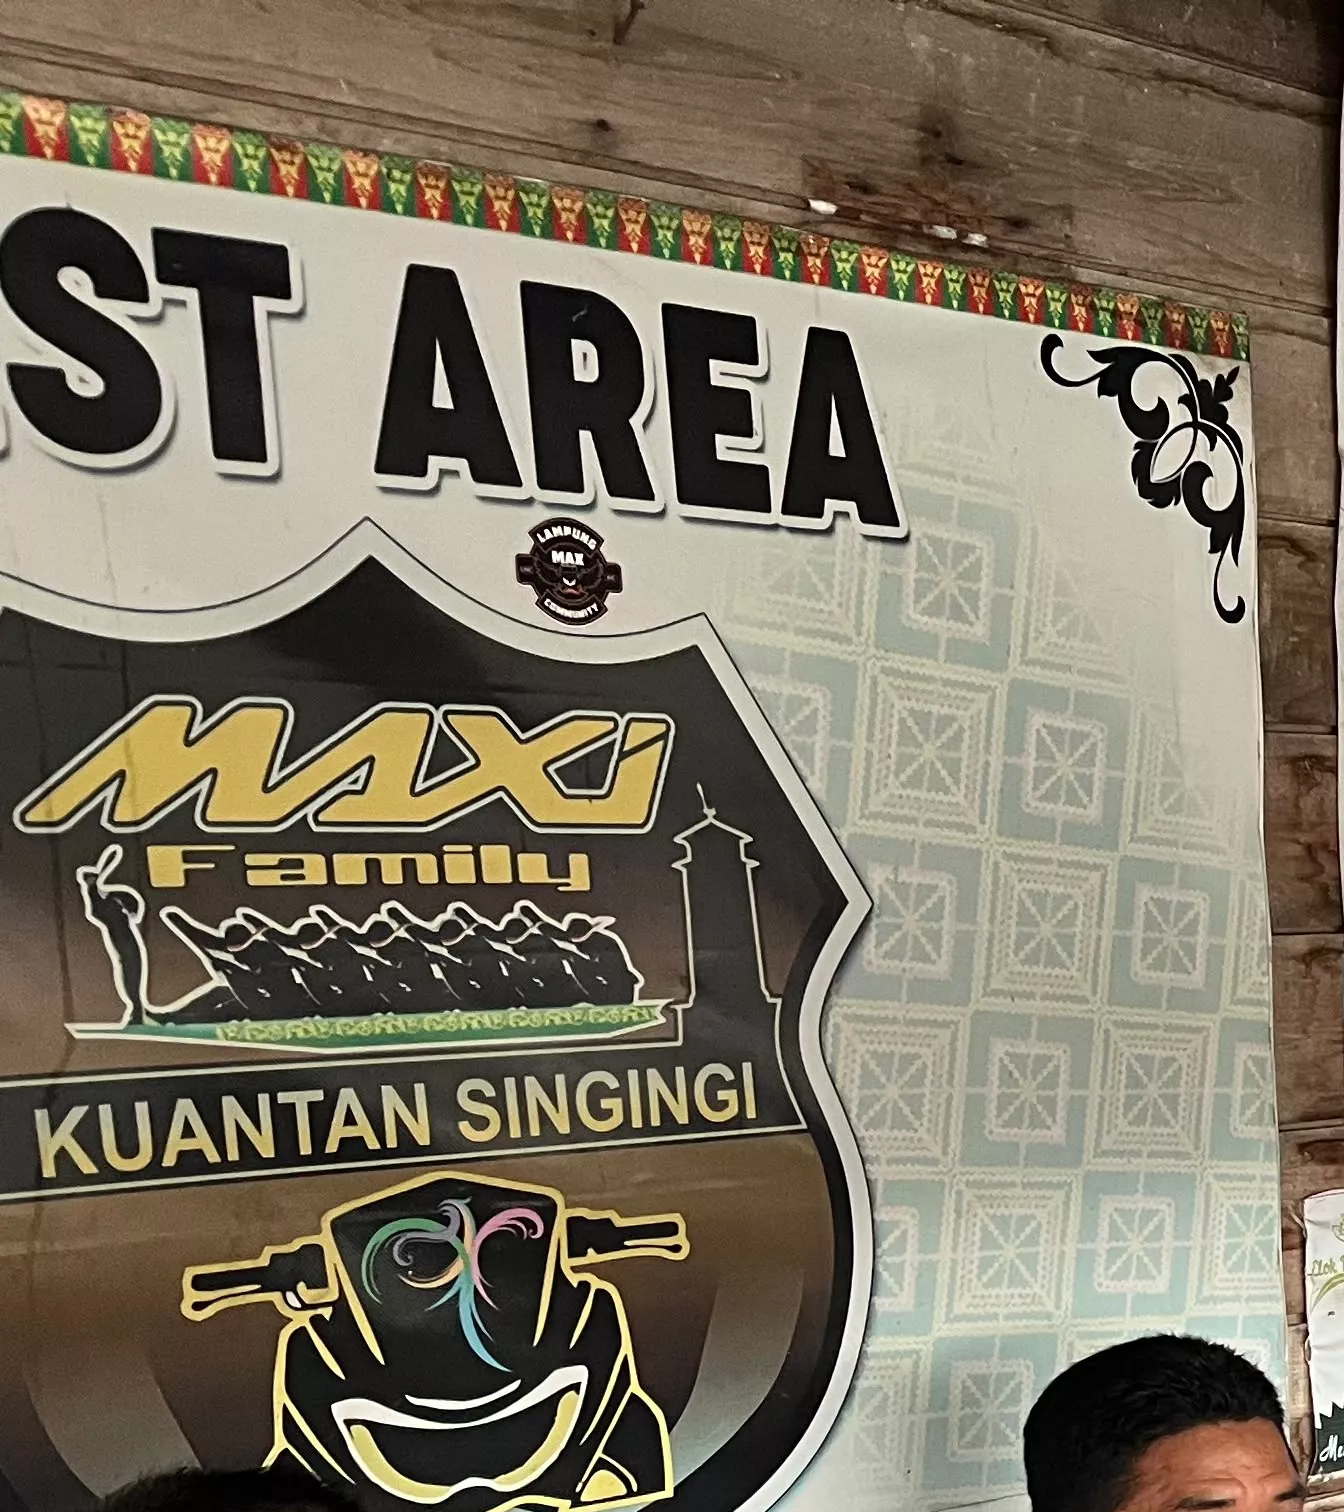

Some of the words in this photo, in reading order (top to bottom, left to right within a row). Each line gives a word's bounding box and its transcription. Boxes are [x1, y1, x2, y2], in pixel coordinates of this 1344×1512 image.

[373, 264, 900, 527] AREA
[536, 525, 597, 550] LAMPUNG
[551, 550, 585, 566] MAX
[145, 843, 592, 894] Family
[33, 1080, 431, 1180] KUANTAN
[457, 1061, 759, 1144] SINGINGI
